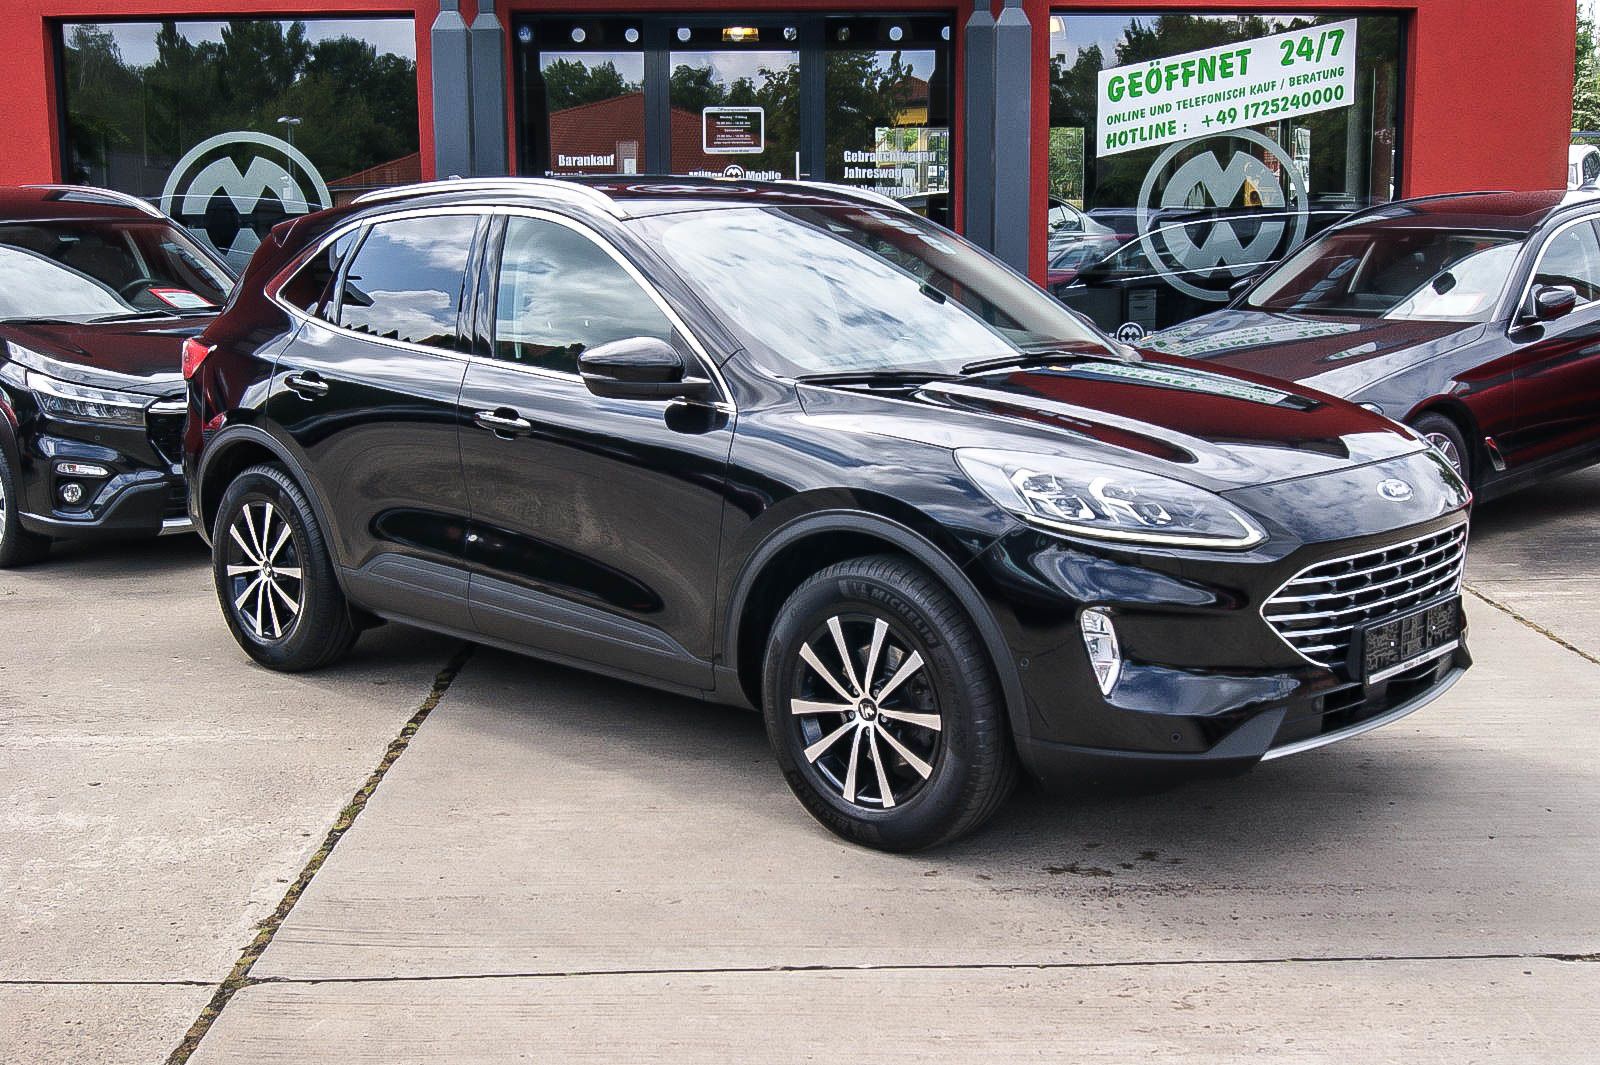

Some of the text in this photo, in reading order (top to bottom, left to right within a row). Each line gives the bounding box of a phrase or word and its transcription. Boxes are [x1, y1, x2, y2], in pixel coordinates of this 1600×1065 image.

[1107, 28, 1345, 103] GEÖFFNET 24/7
[1105, 120, 1177, 150] HOTLINE
[1201, 107, 1237, 128] +49
[1244, 84, 1345, 120] 1725240000
[1106, 109, 1146, 125] ONLINE
[1149, 103, 1172, 116] UND
[1176, 87, 1246, 111] TELEFONISCH
[1249, 80, 1277, 96] KAUF
[1288, 66, 1345, 87] BERATUNG
[558, 153, 614, 166] Barankauf
[871, 588, 938, 646] MICHELIN
